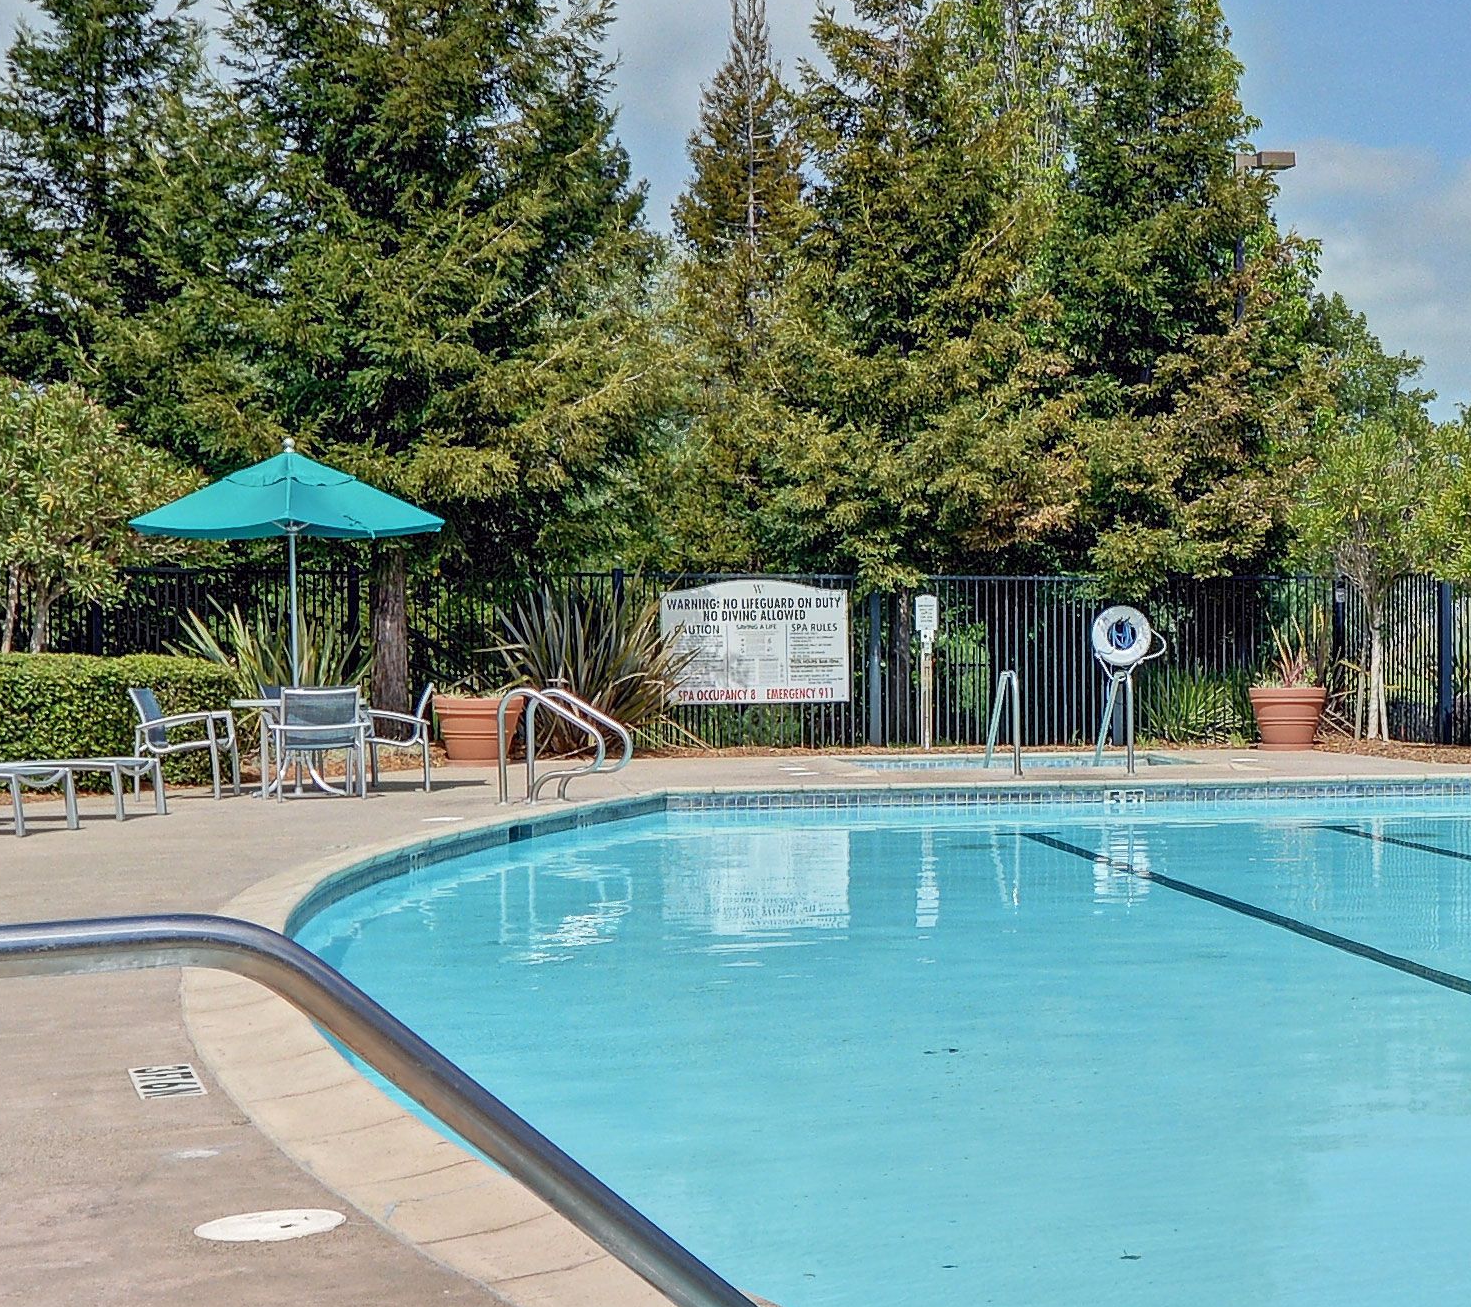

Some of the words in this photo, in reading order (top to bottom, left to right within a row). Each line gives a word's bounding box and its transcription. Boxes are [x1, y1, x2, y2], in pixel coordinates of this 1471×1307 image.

[667, 598, 720, 610] WARNING:
[723, 598, 738, 610] NO
[742, 597, 795, 610] LIFEGUARD
[797, 597, 812, 609] ON
[816, 596, 841, 608] DUTY
[703, 610, 718, 622] NO
[722, 610, 757, 622] DIVING
[760, 609, 806, 621] ALLOWED
[791, 623, 808, 632] SPA
[810, 623, 838, 632] RULES
[678, 690, 694, 701] SPA
[697, 689, 748, 701] OCCUPANCY
[750, 689, 756, 700] 8
[767, 688, 816, 700] EMERGENCY
[818, 687, 834, 699] 911
